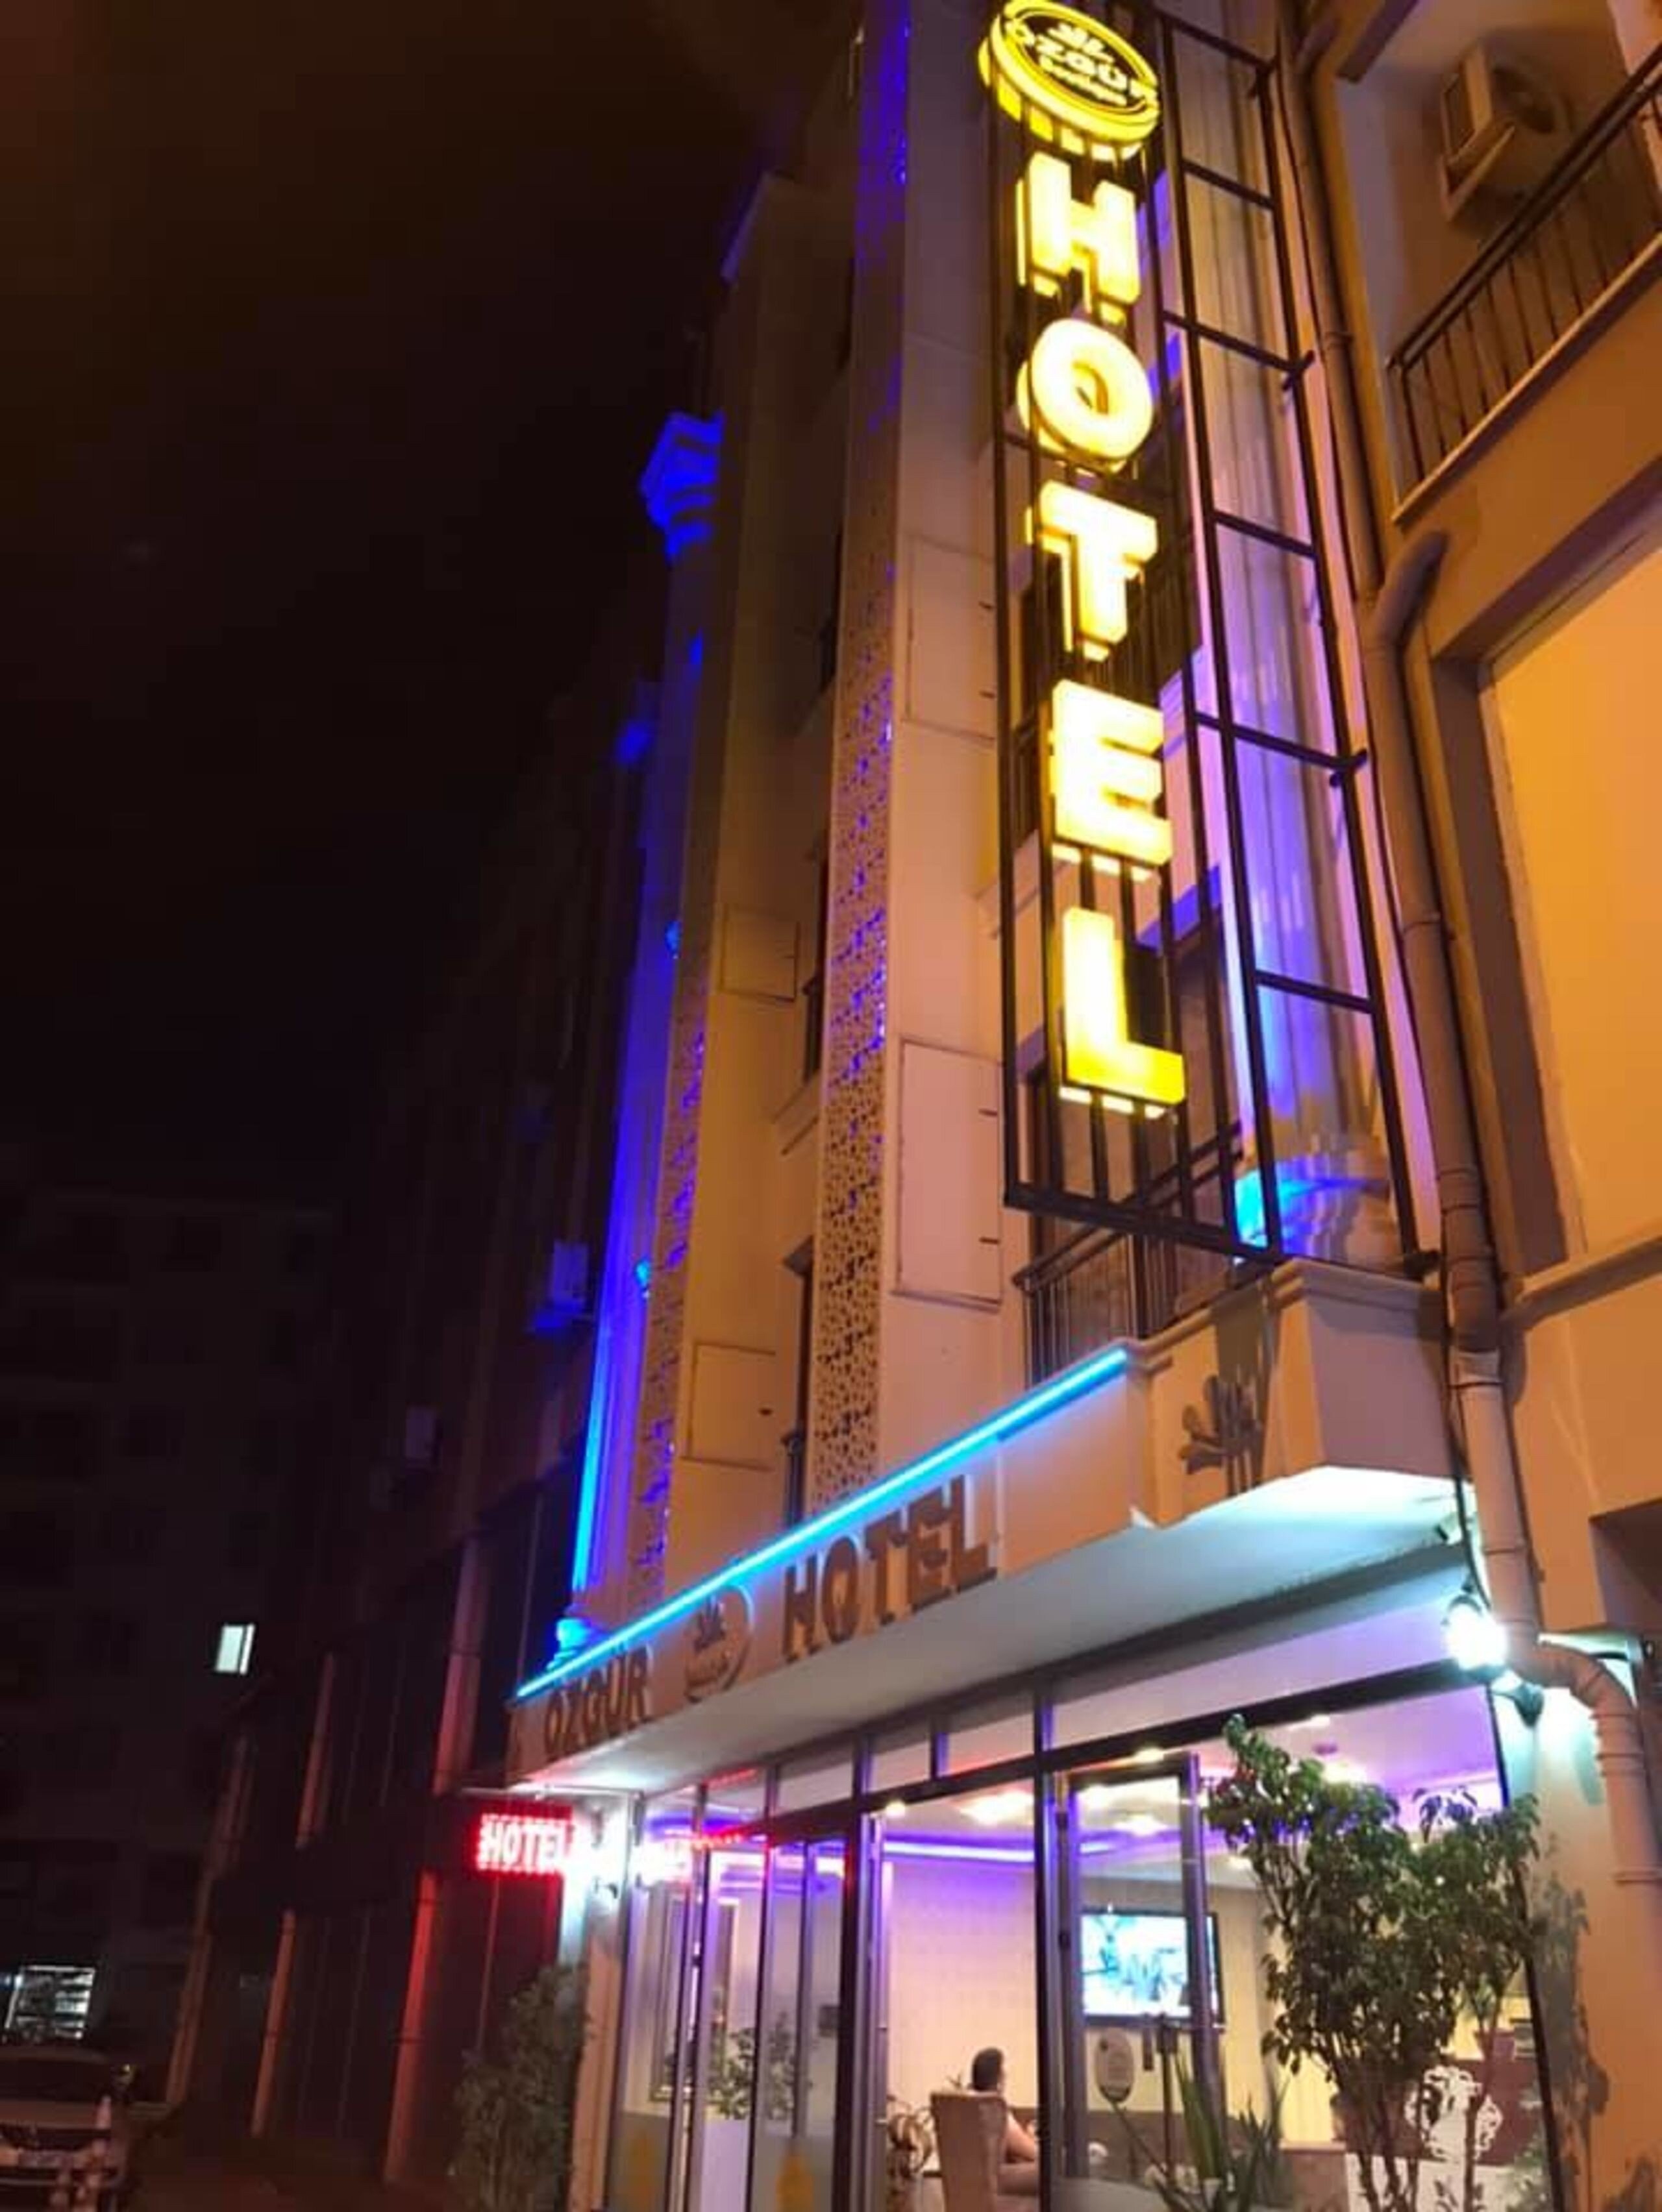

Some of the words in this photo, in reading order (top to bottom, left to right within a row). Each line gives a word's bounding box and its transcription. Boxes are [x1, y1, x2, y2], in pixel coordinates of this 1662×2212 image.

[1026, 151, 1186, 1106] HOTEL
[782, 1474, 998, 1664] HOTEL
[478, 1818, 574, 1869] HOTEL
